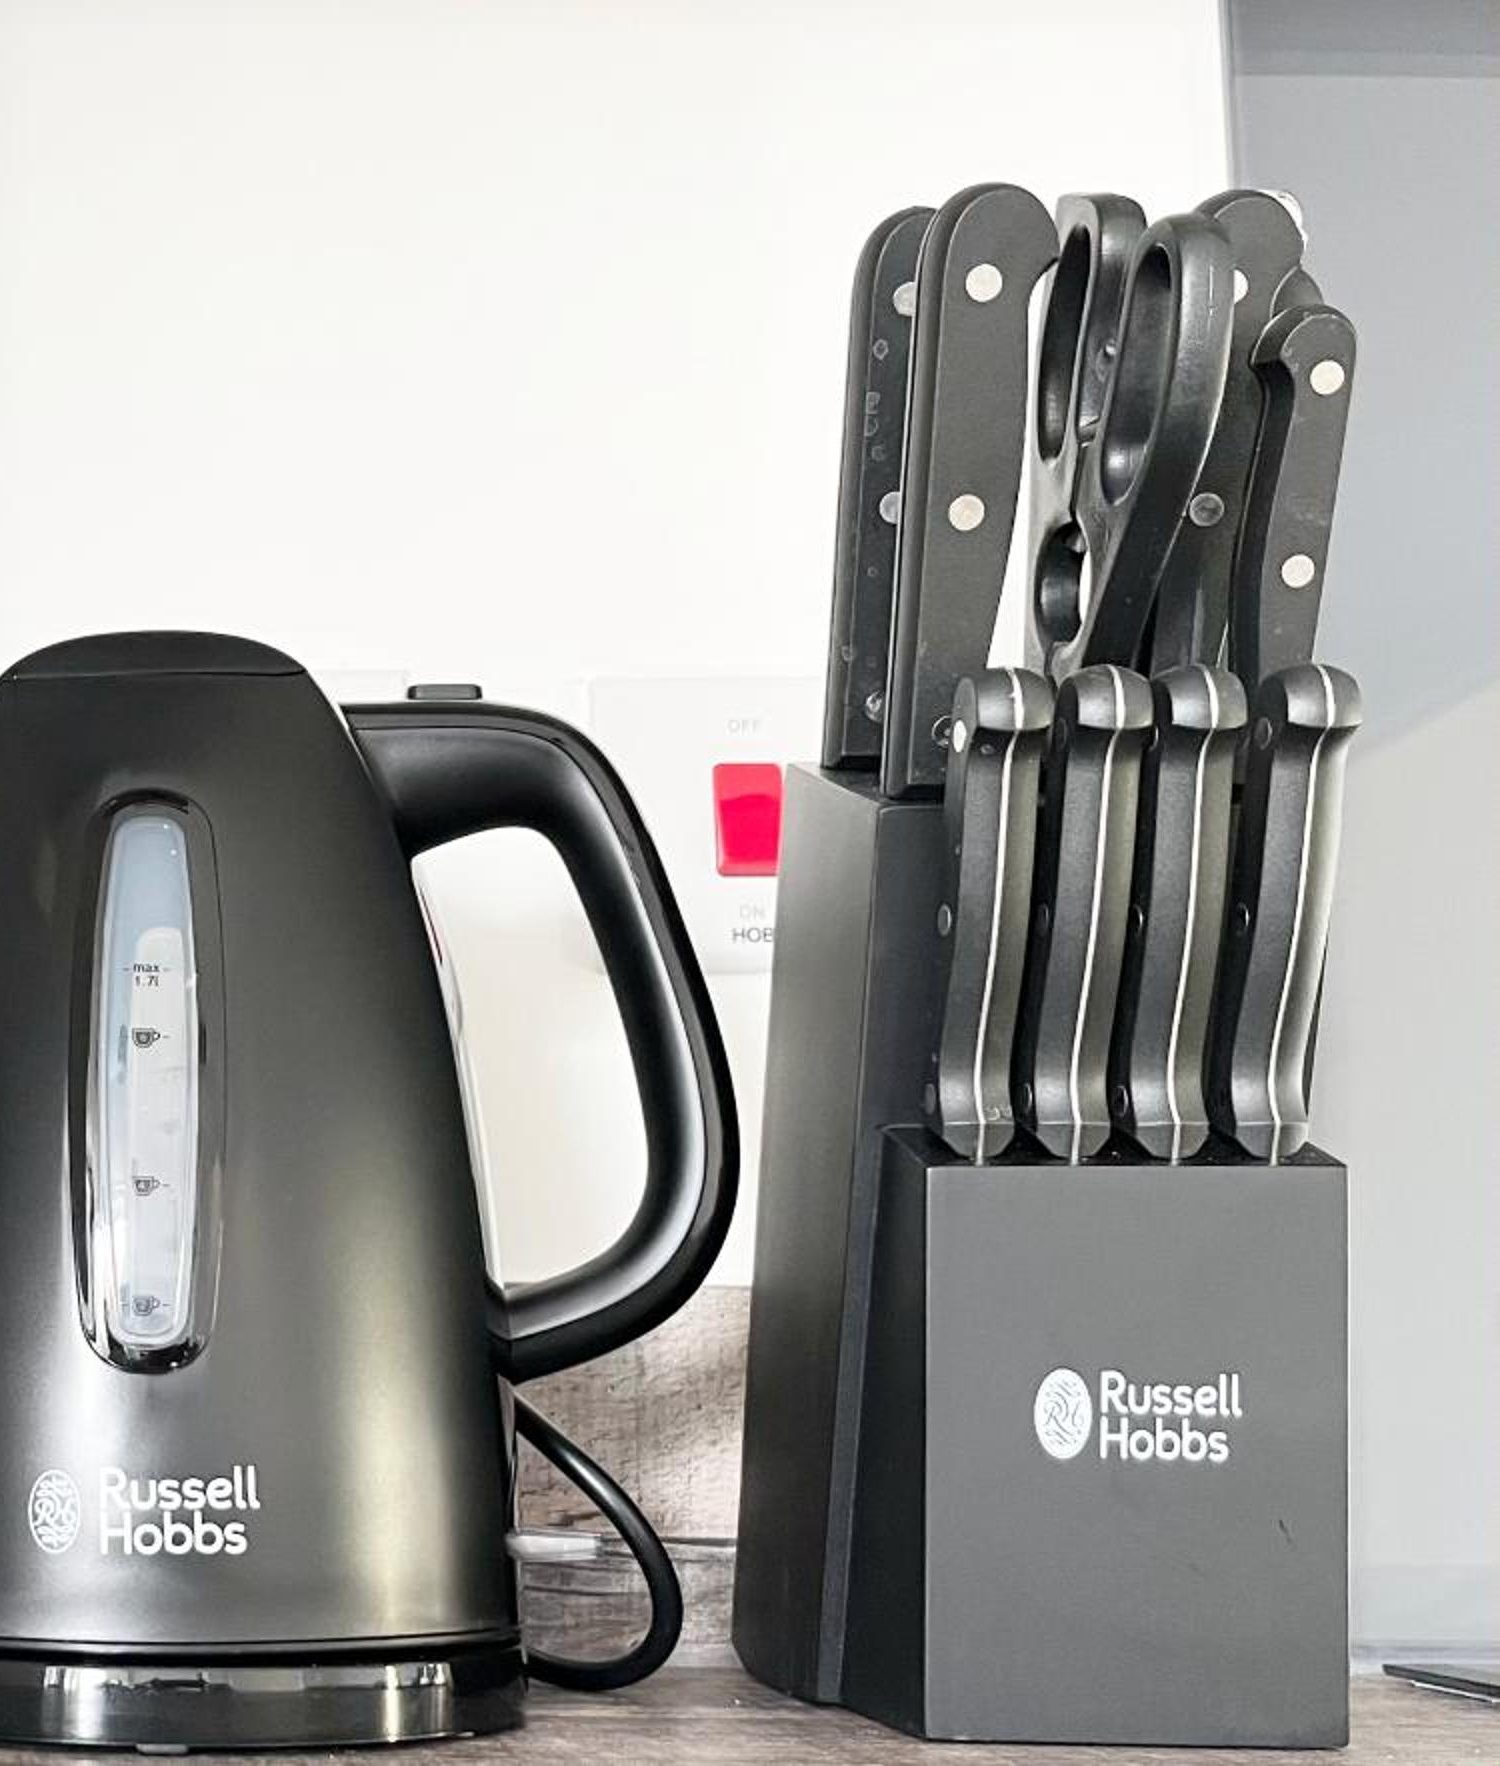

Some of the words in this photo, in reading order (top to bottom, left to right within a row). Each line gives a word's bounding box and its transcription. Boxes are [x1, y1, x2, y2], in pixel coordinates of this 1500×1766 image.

[132, 963, 160, 973] max
[1099, 1369, 1243, 1418] Russell
[1099, 1415, 1229, 1463] Hobbs
[99, 1464, 261, 1512] Russell
[99, 1509, 249, 1556] Hobbs
